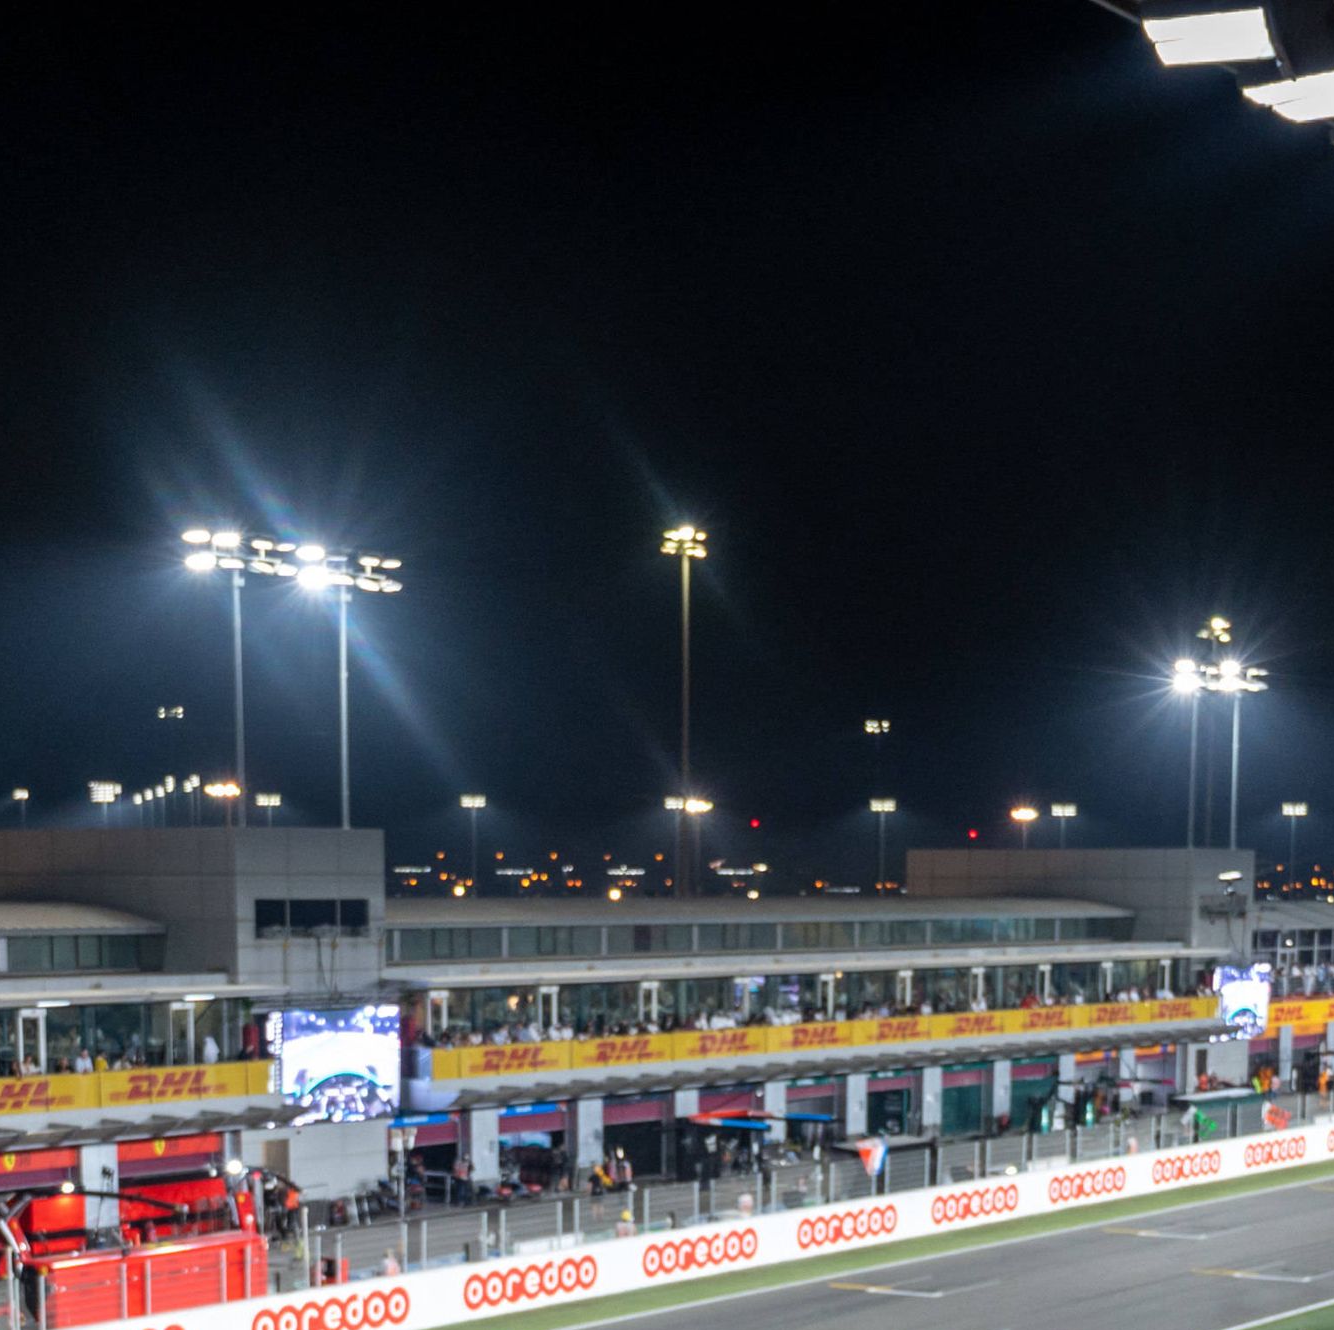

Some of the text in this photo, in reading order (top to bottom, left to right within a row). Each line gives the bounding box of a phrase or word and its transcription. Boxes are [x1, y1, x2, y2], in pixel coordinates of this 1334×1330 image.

[595, 1038, 654, 1063] DHL
[697, 1031, 750, 1055] DHL
[790, 1025, 840, 1048] DHL
[482, 1046, 546, 1072] DHL
[127, 1069, 212, 1101] DHL
[1153, 1150, 1220, 1185] ooredoo
[1244, 1135, 1307, 1168] ooredoo
[1049, 1166, 1126, 1204] ooredoo
[931, 1183, 1019, 1225] ooredoo
[796, 1204, 897, 1250] ooredoo
[642, 1227, 758, 1278] ooredoo
[463, 1254, 598, 1311] ooredoo
